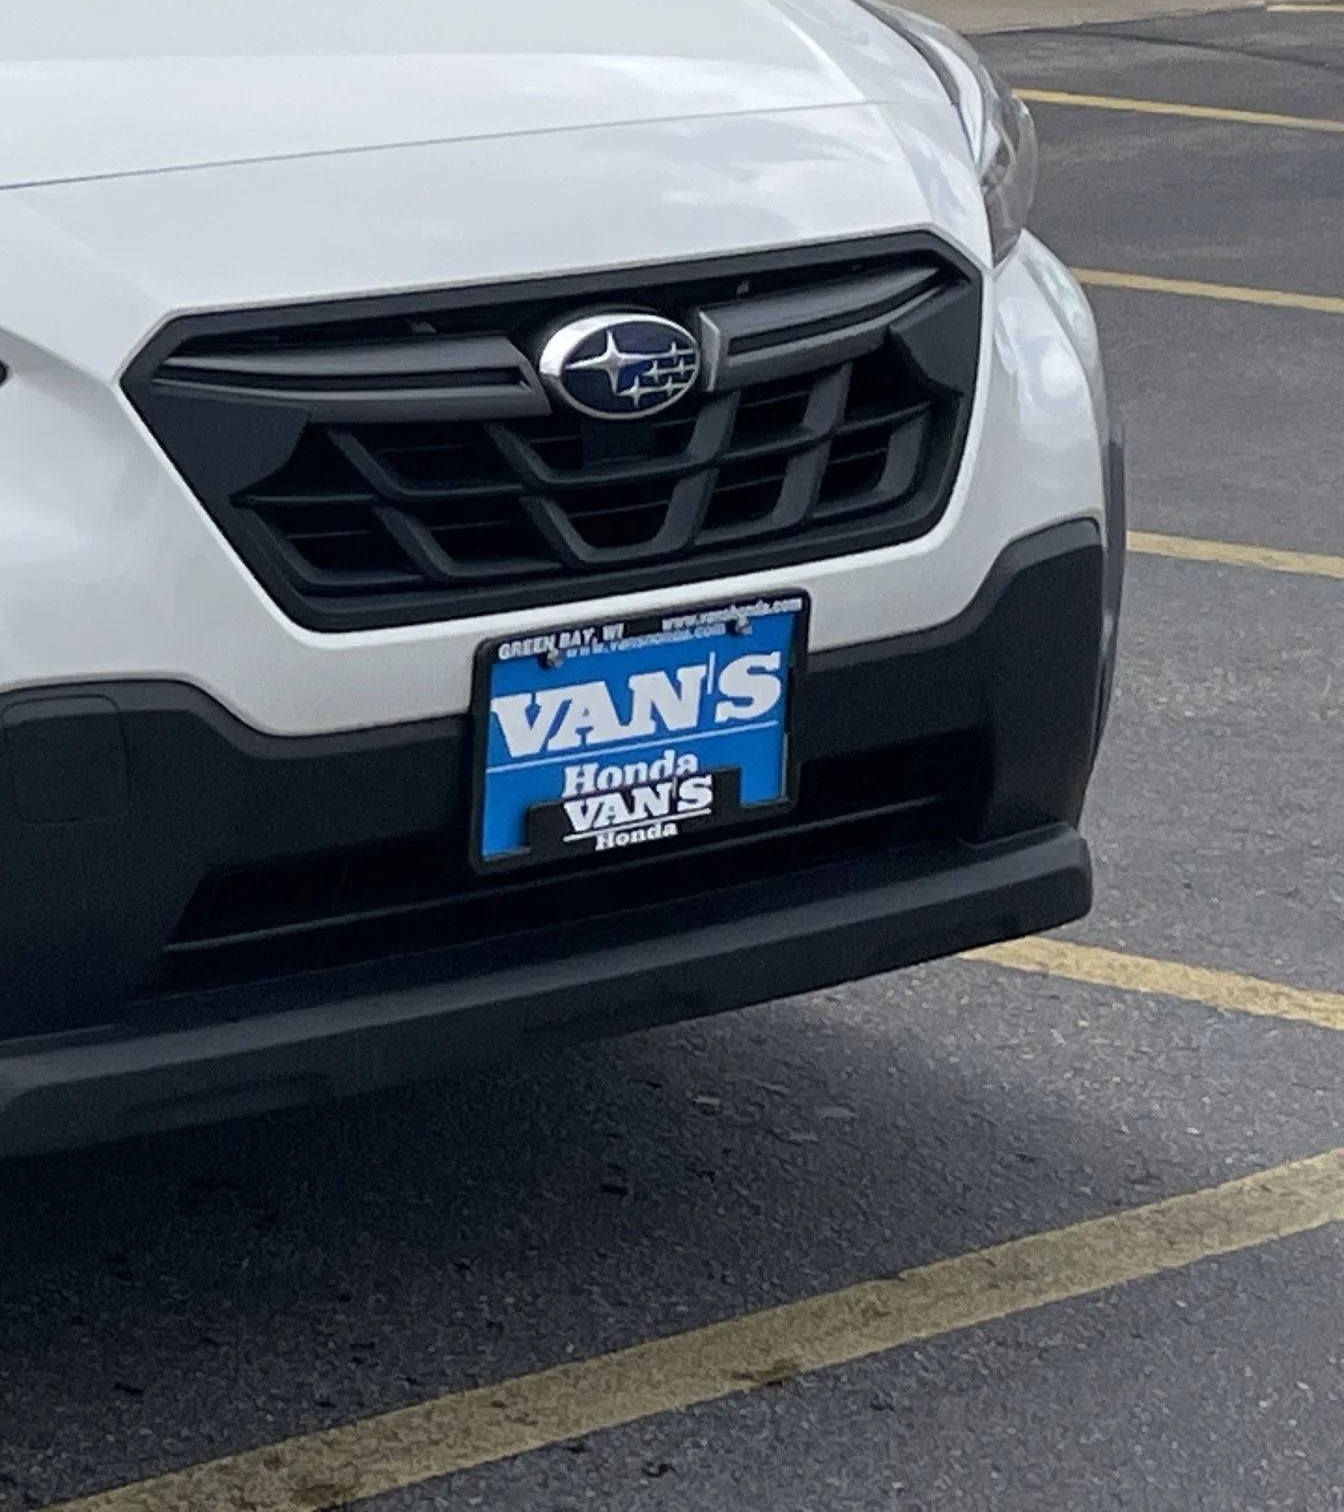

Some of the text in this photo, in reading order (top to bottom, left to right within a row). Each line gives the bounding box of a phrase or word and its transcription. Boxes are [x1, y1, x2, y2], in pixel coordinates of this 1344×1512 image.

[498, 633, 555, 660] GREEN
[602, 623, 624, 640] WI
[491, 651, 782, 758] VAN'S
[562, 750, 698, 797] Honda
[563, 775, 713, 832] VAN'S
[595, 821, 678, 851] Honda
